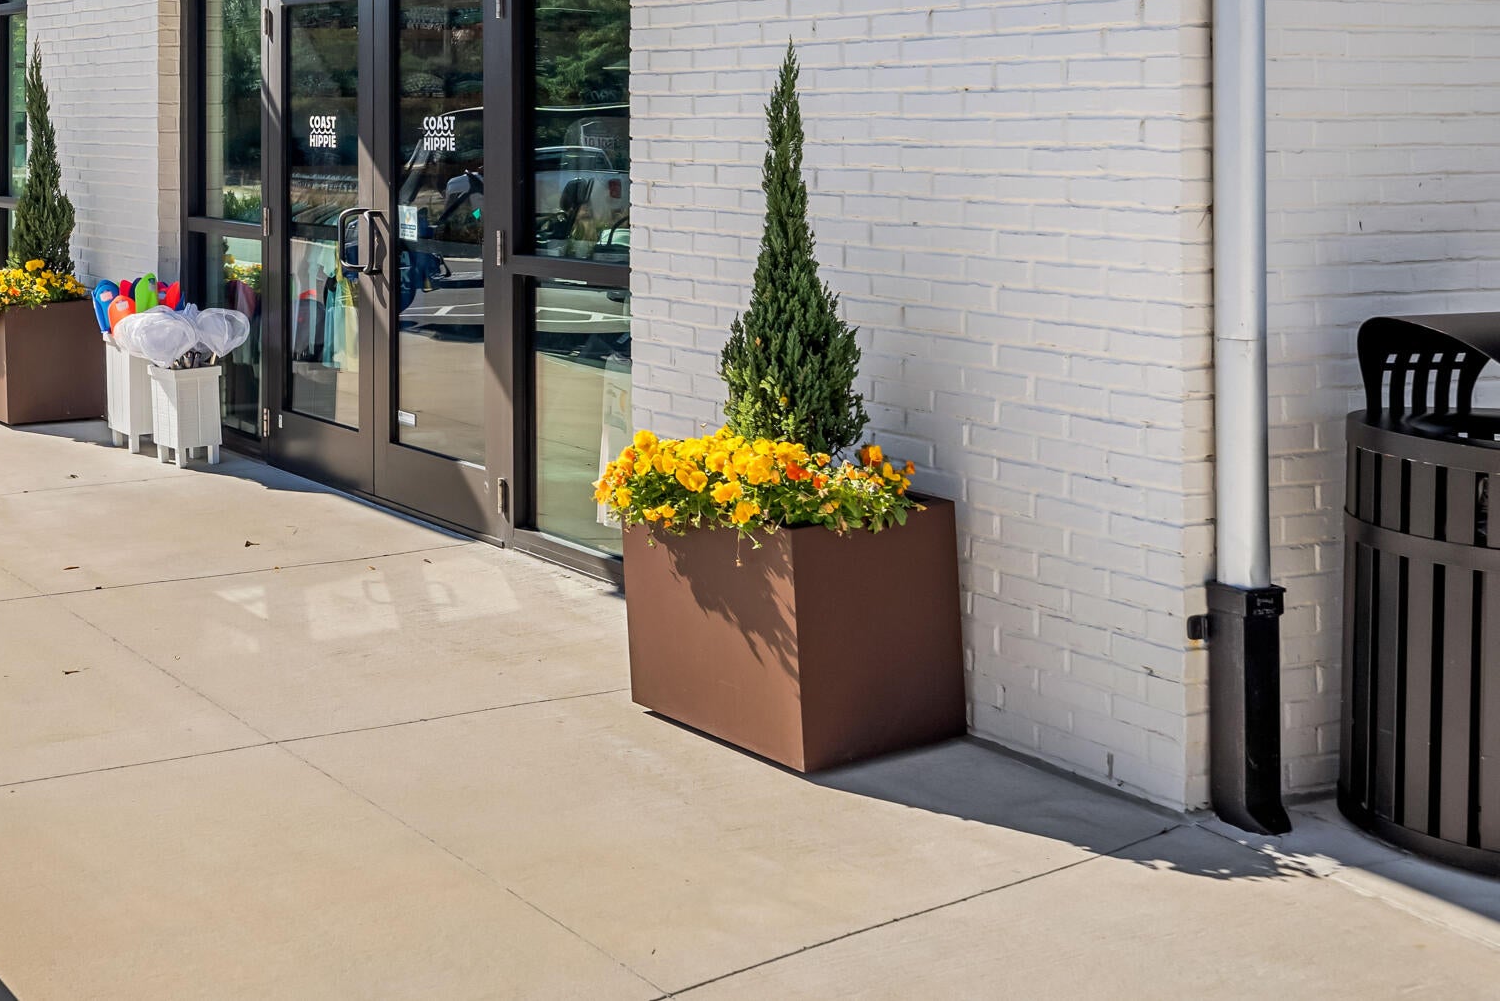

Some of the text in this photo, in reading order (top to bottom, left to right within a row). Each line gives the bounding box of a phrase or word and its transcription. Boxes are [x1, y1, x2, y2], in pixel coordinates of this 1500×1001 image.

[309, 116, 336, 129] COAST
[423, 116, 455, 131] COAST
[309, 134, 336, 148] HIPPIE
[423, 136, 456, 151] HIPPIE
